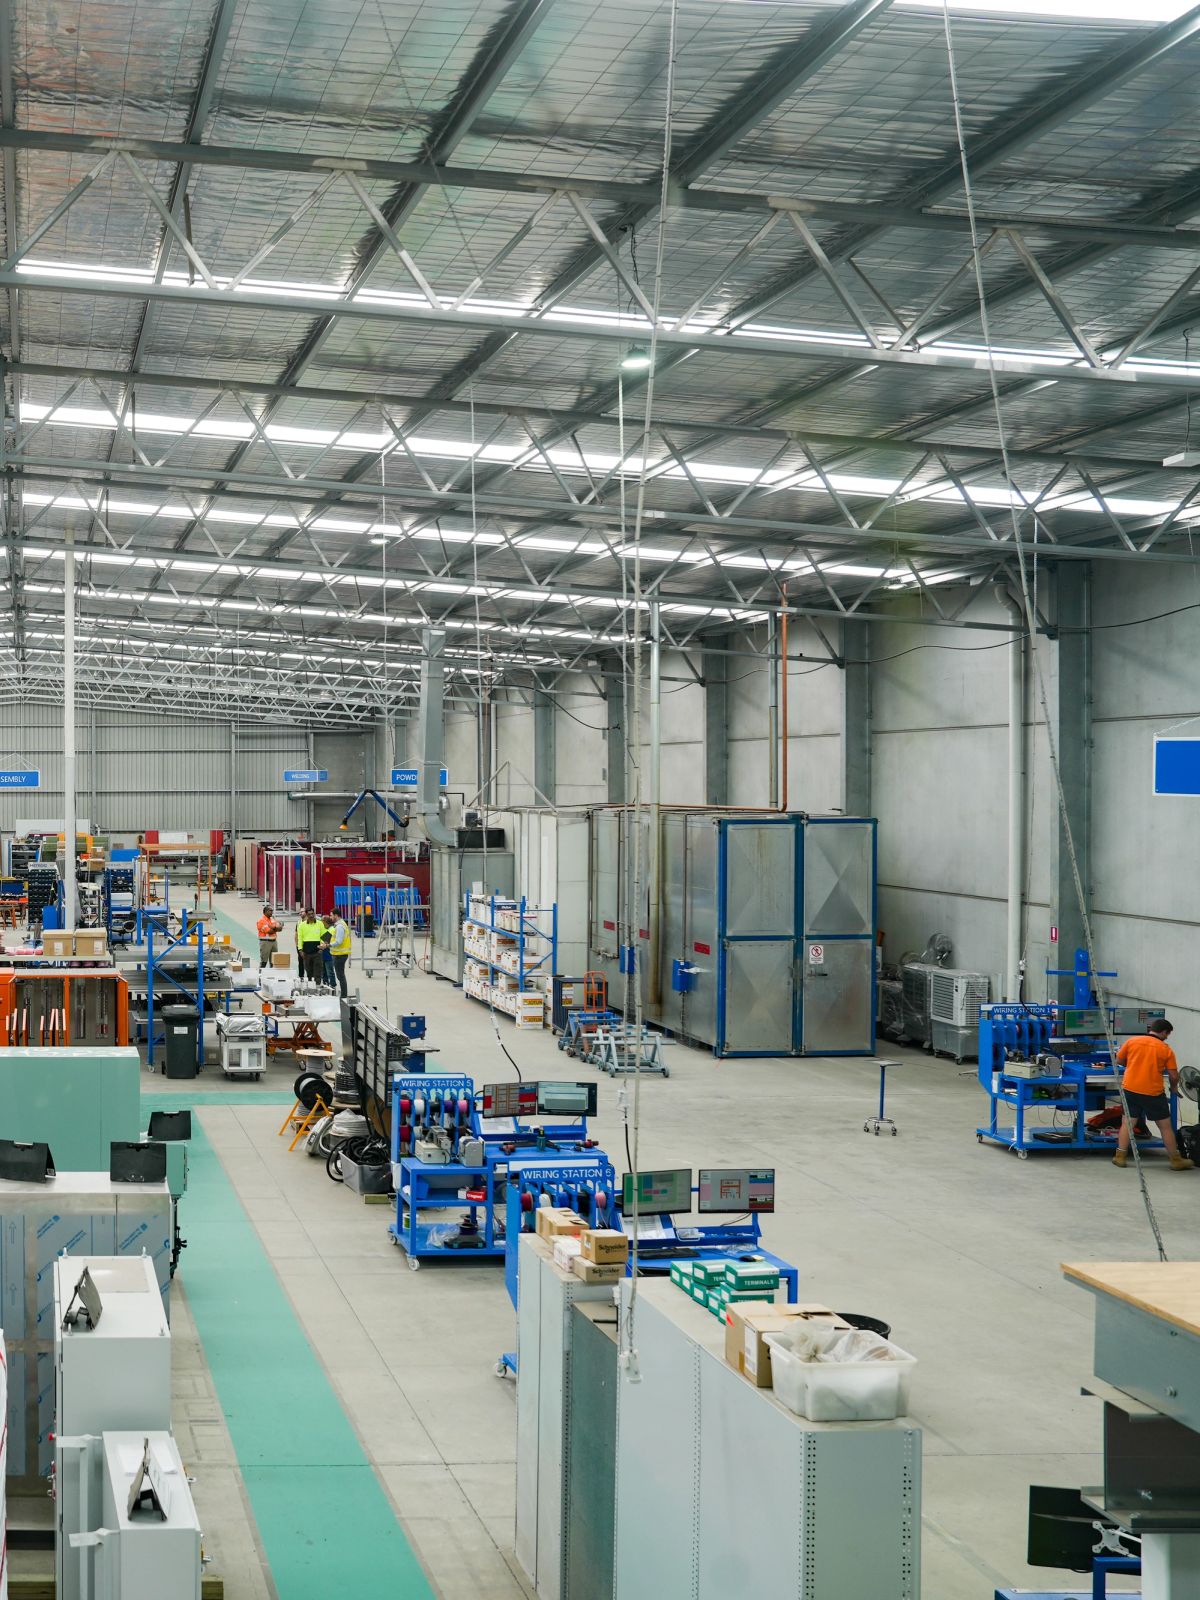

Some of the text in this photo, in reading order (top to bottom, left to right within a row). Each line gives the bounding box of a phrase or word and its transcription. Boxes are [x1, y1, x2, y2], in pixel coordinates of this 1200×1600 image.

[401, 1079, 430, 1087] WIRING
[432, 1079, 464, 1087] STATION
[522, 1168, 612, 1179] WIRING STATION 6
